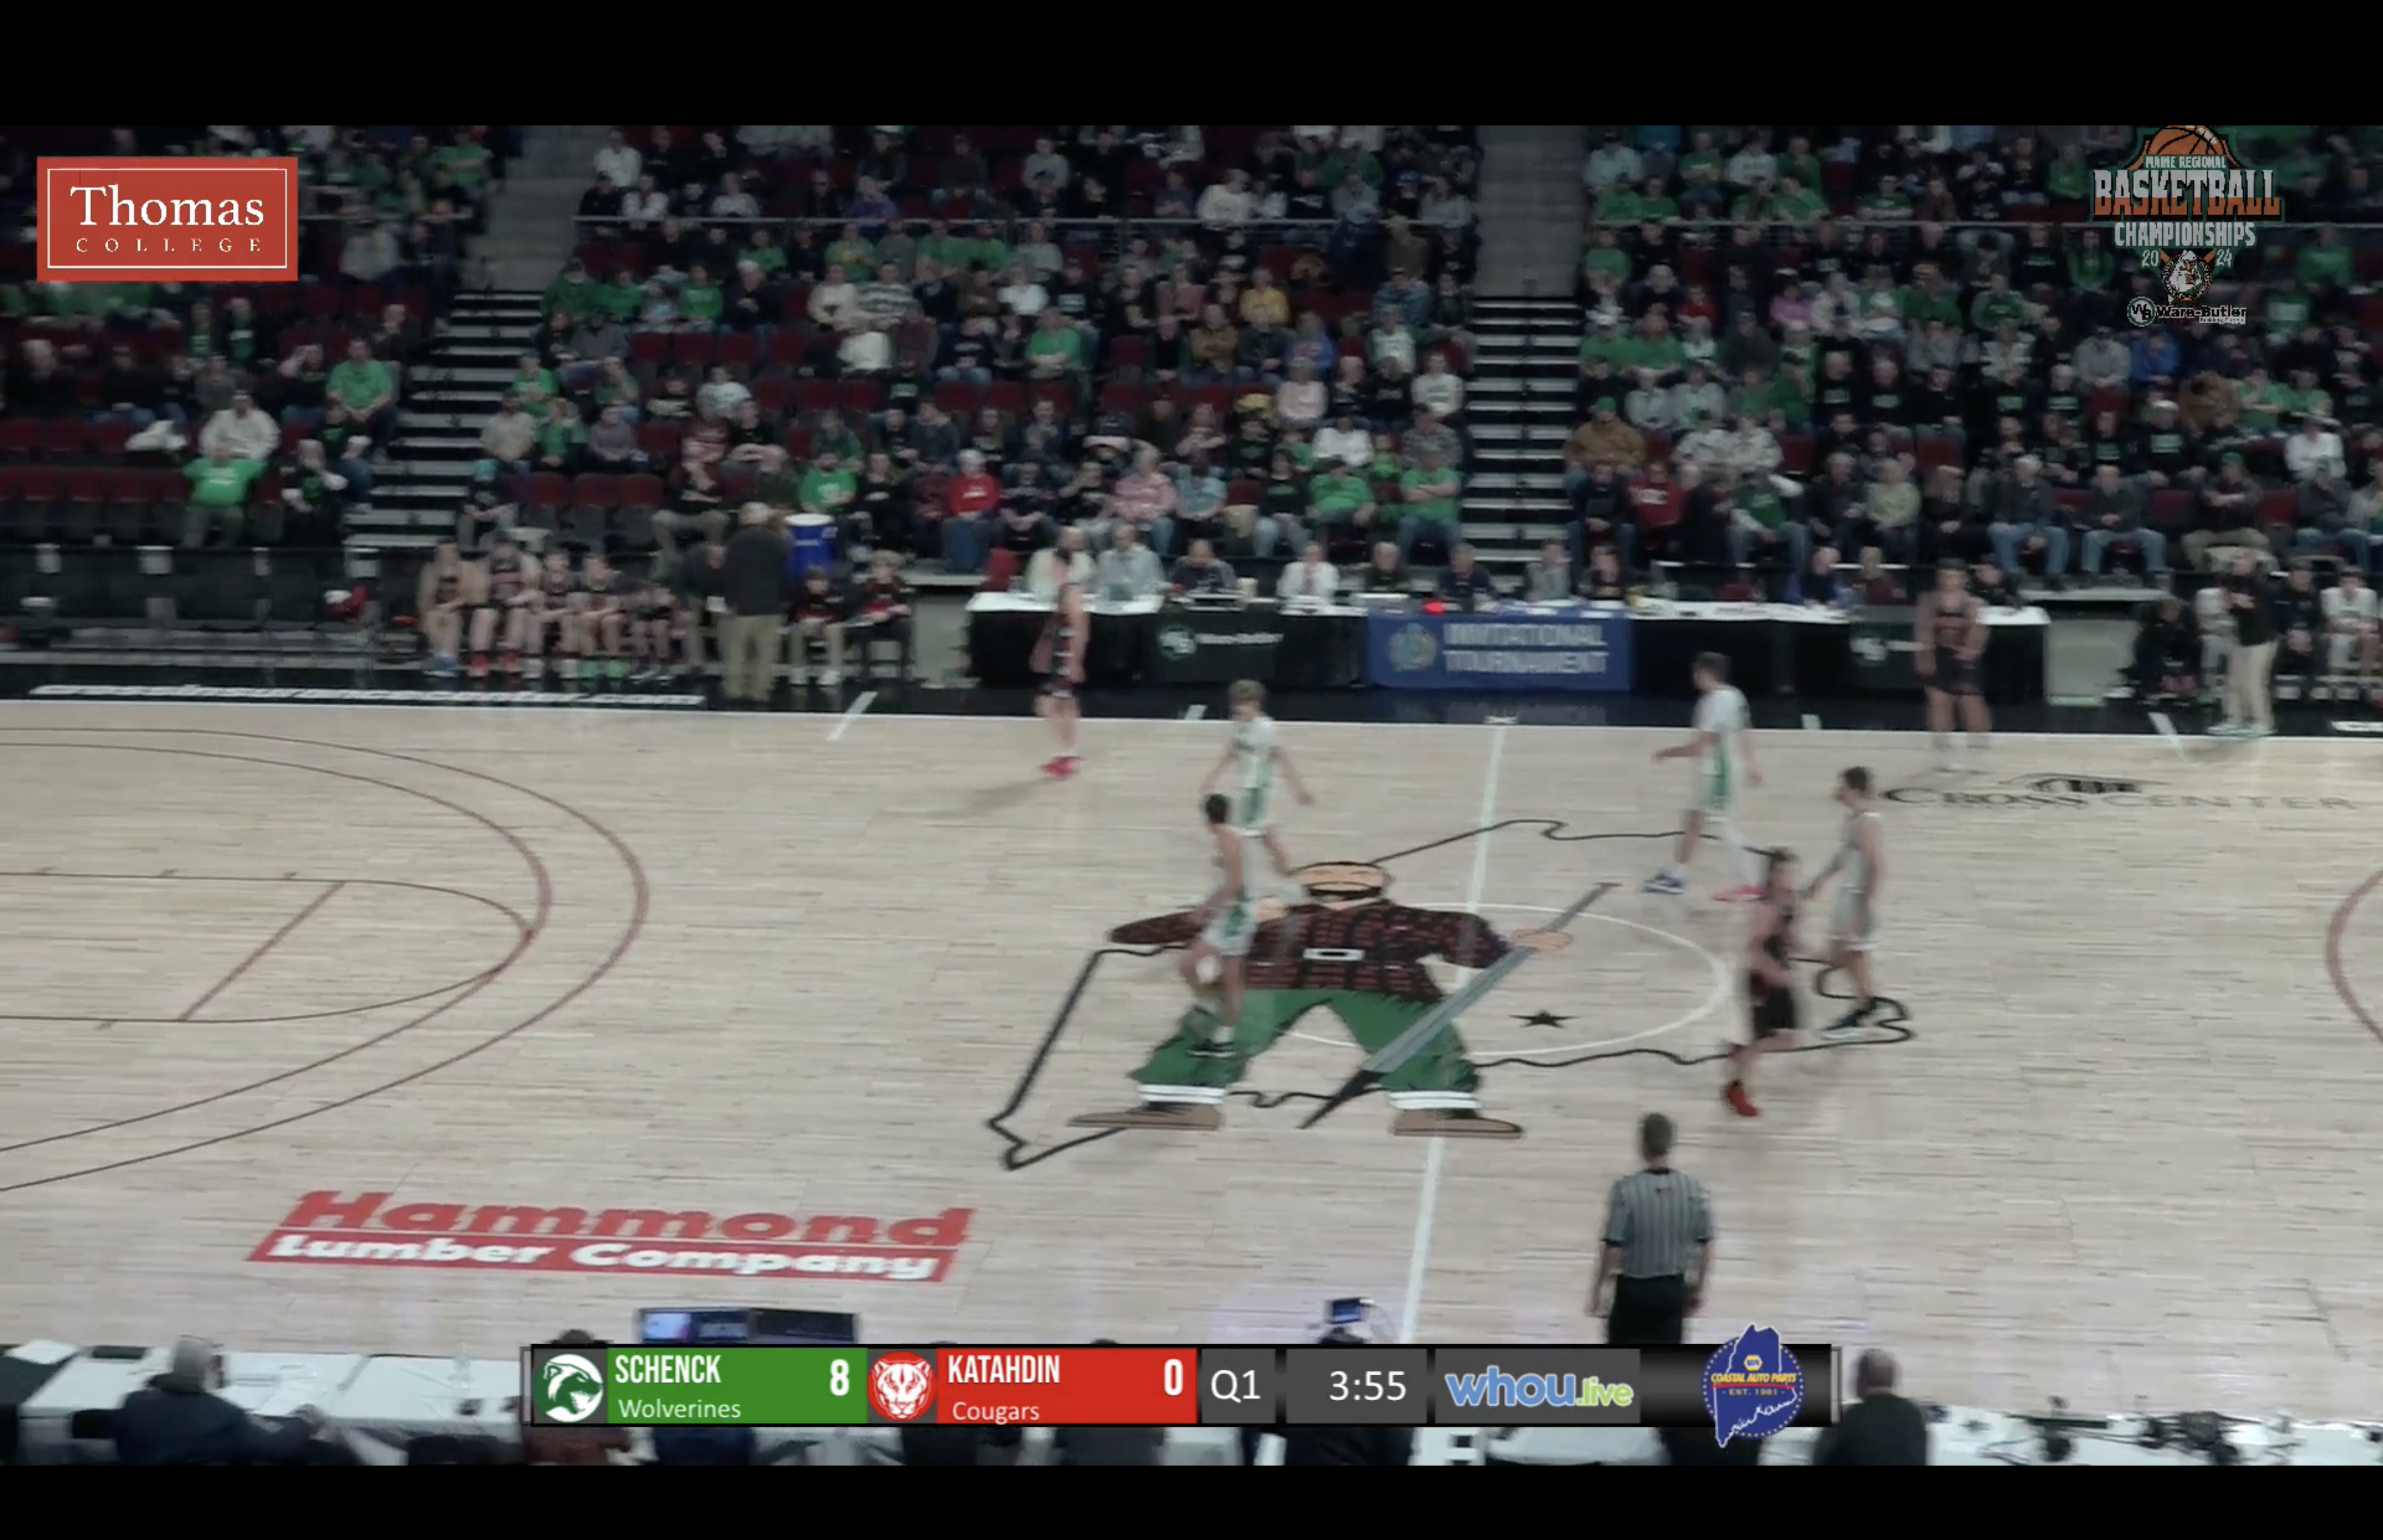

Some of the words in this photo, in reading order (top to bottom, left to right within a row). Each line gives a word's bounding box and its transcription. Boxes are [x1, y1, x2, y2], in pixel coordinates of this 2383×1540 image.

[283, 1190, 975, 1246] Hammond
[267, 1233, 556, 1265] Lumber
[570, 1243, 941, 1280] Company
